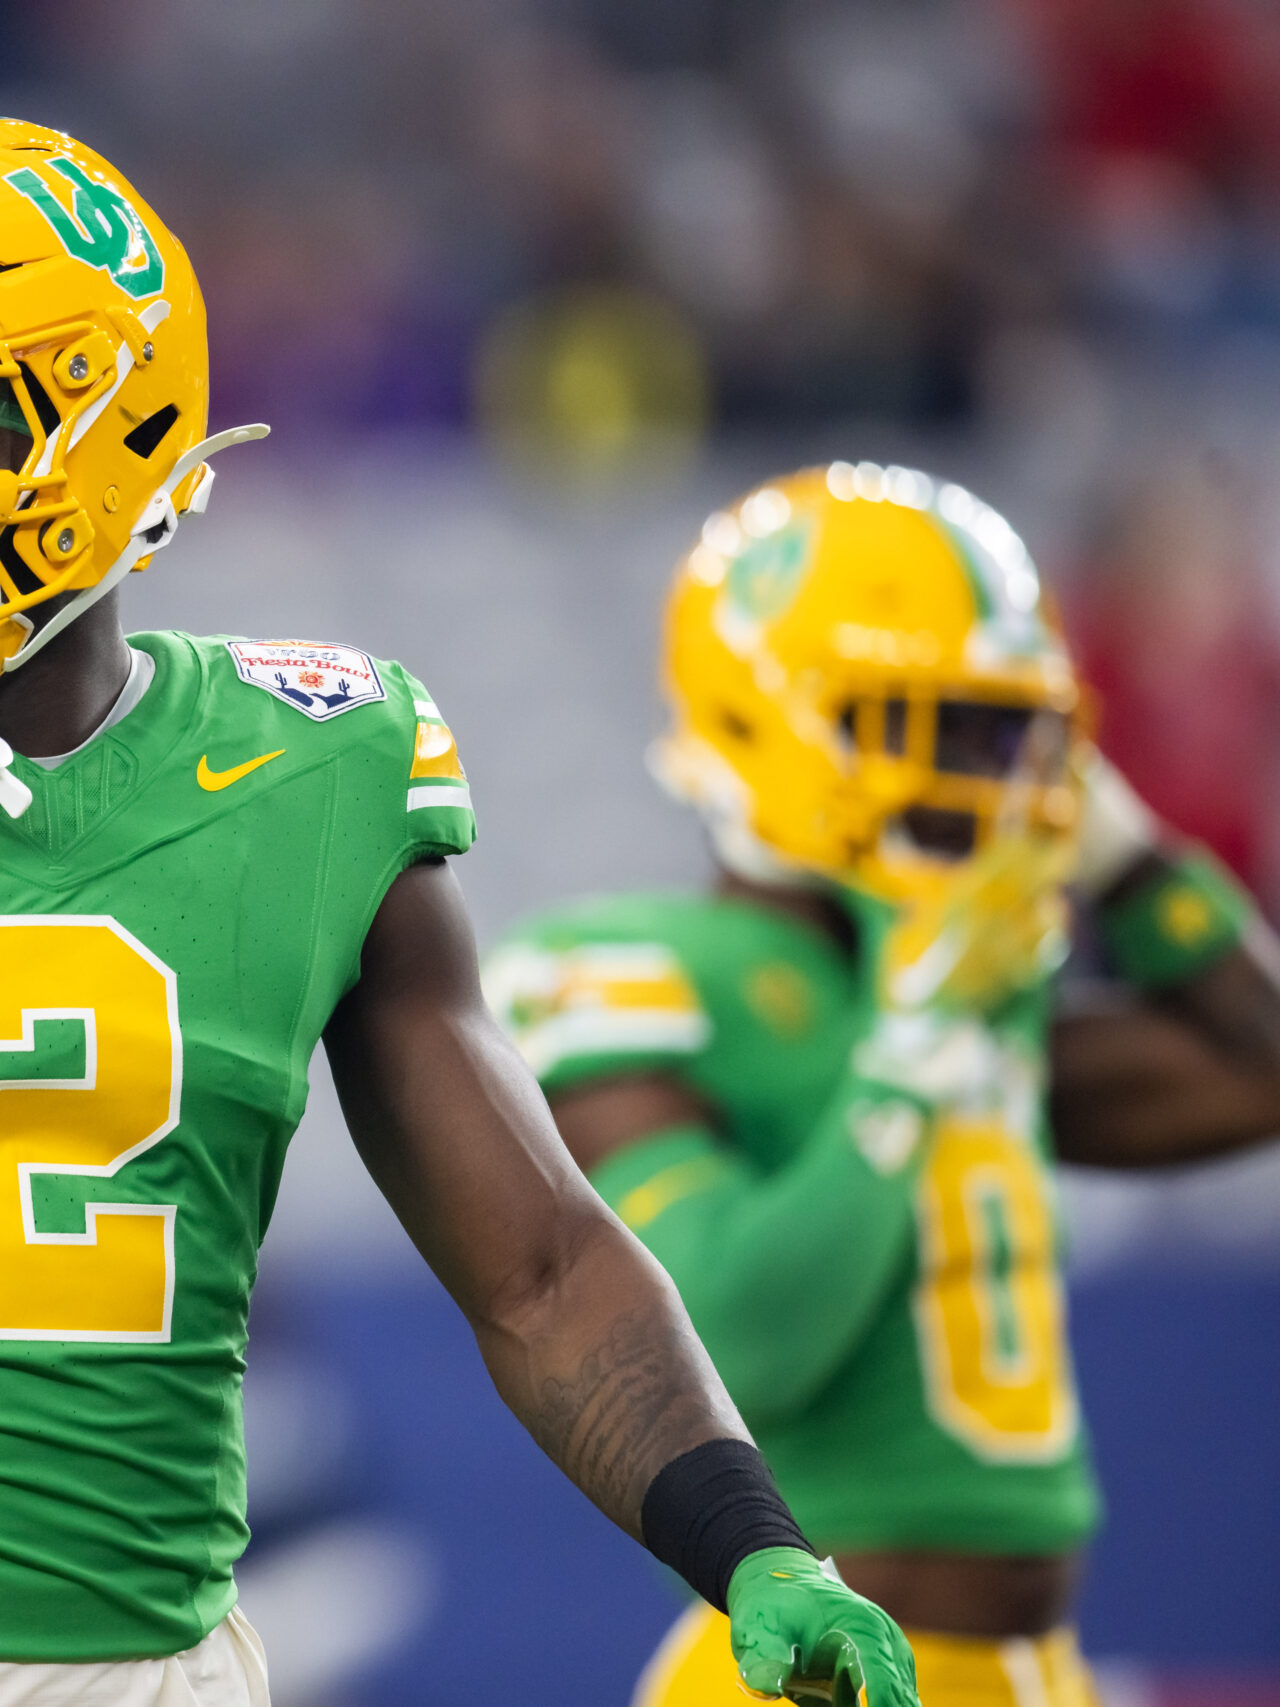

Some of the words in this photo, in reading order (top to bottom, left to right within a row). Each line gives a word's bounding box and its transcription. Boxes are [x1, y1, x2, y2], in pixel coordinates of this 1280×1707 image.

[240, 656, 309, 667] Fiesta
[310, 659, 371, 681] Bowl
[913, 1108, 1081, 1465] 0
